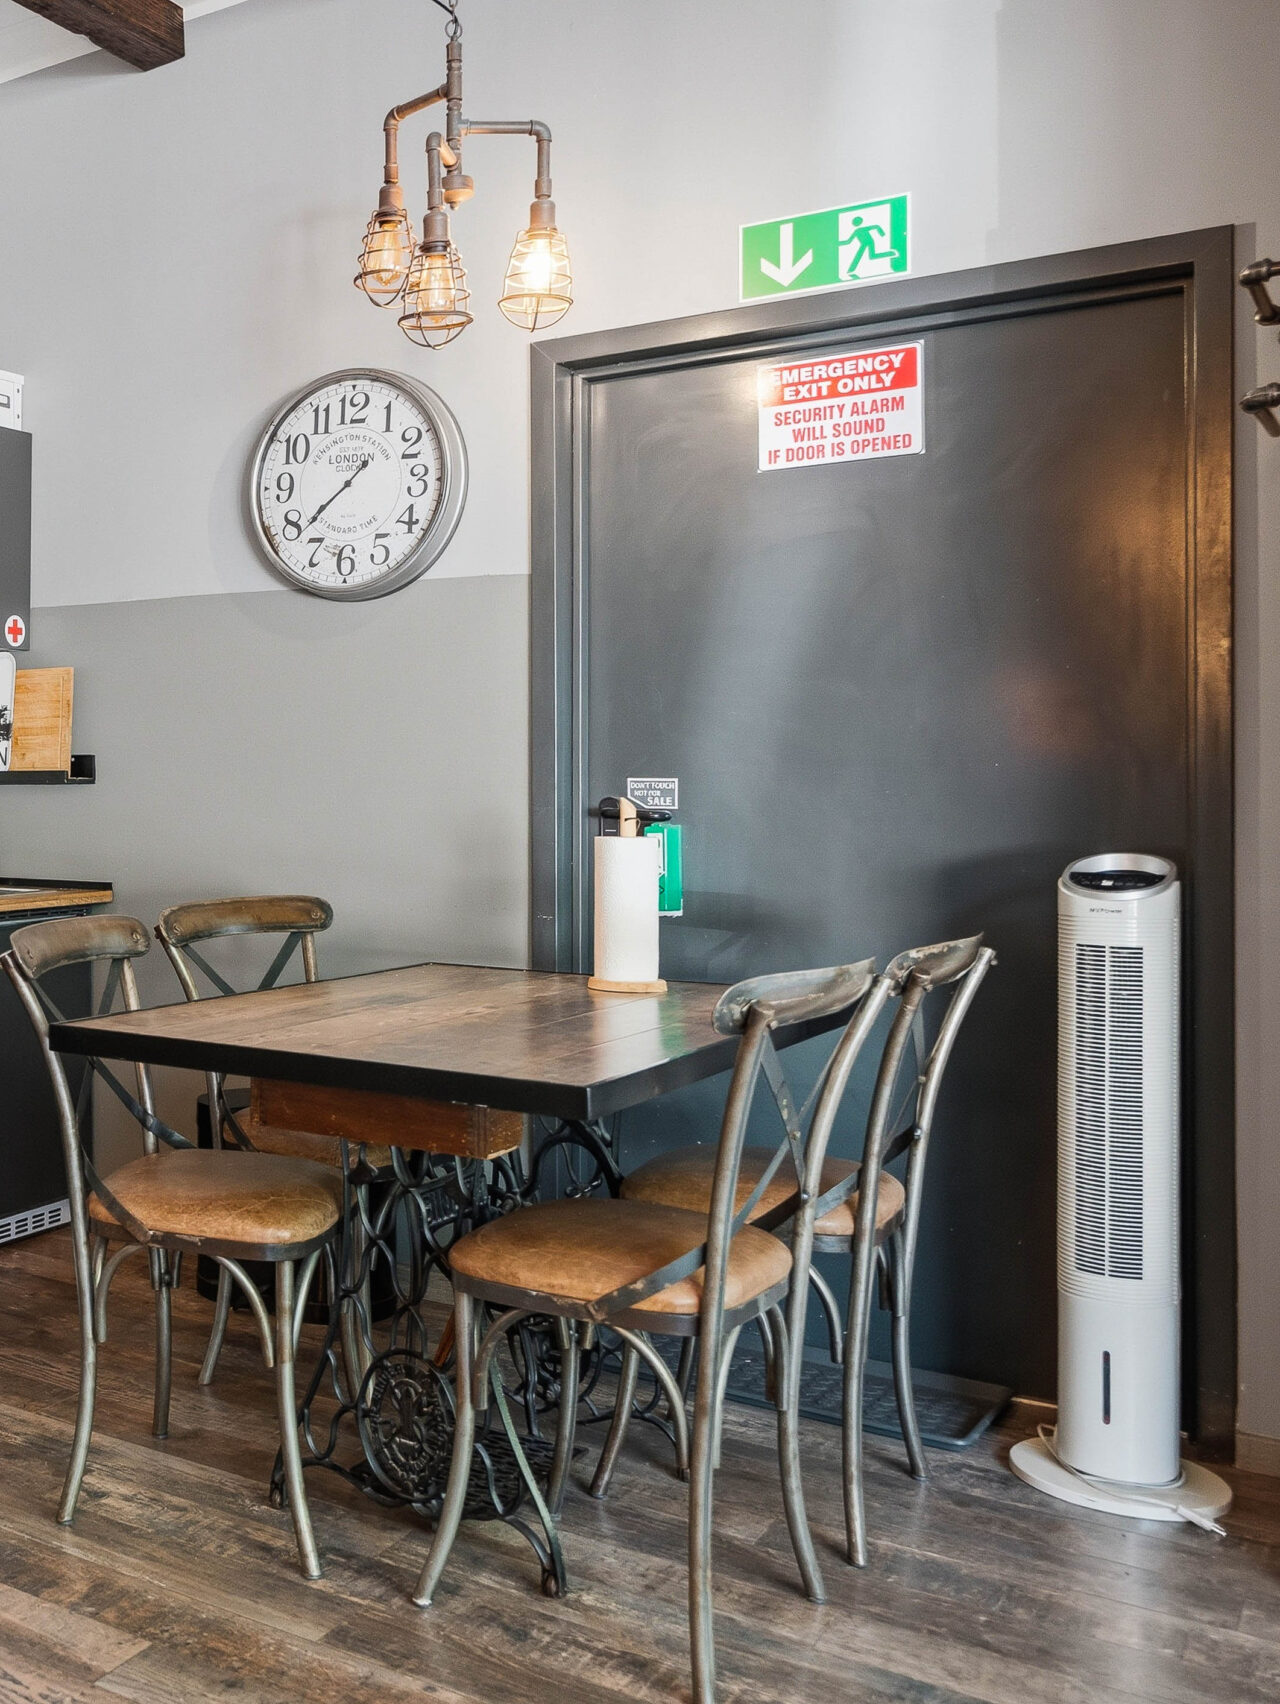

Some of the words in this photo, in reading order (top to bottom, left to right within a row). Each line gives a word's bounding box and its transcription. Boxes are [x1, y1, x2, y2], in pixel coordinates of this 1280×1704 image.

[784, 382, 832, 401] EXIT
[837, 371, 896, 393] ONLY
[310, 403, 333, 436] 11
[336, 392, 370, 425] 12
[382, 400, 394, 433] 1
[774, 403, 845, 426] SECURITY
[850, 396, 905, 417] ALARM
[400, 426, 423, 460] 2
[792, 425, 827, 443] WILL
[832, 417, 885, 438] SOUND
[282, 432, 310, 465] 10
[313, 434, 361, 465] KENSINGTON
[363, 434, 391, 461] STATION
[328, 452, 375, 465] LONDON
[768, 449, 780, 464] IF
[785, 444, 825, 462] DOOR
[831, 442, 845, 457] IS
[850, 433, 912, 454] OPENED
[336, 464, 366, 472] CLOCK
[406, 463, 429, 498] 3
[275, 472, 295, 504] 9
[282, 509, 302, 542] 8
[318, 517, 358, 534] STANDARD
[360, 514, 378, 530] TIME
[395, 503, 420, 535] 4
[306, 537, 326, 568] 7
[336, 544, 356, 577] 6
[370, 533, 391, 566] 5
[647, 796, 672, 806] SALE
